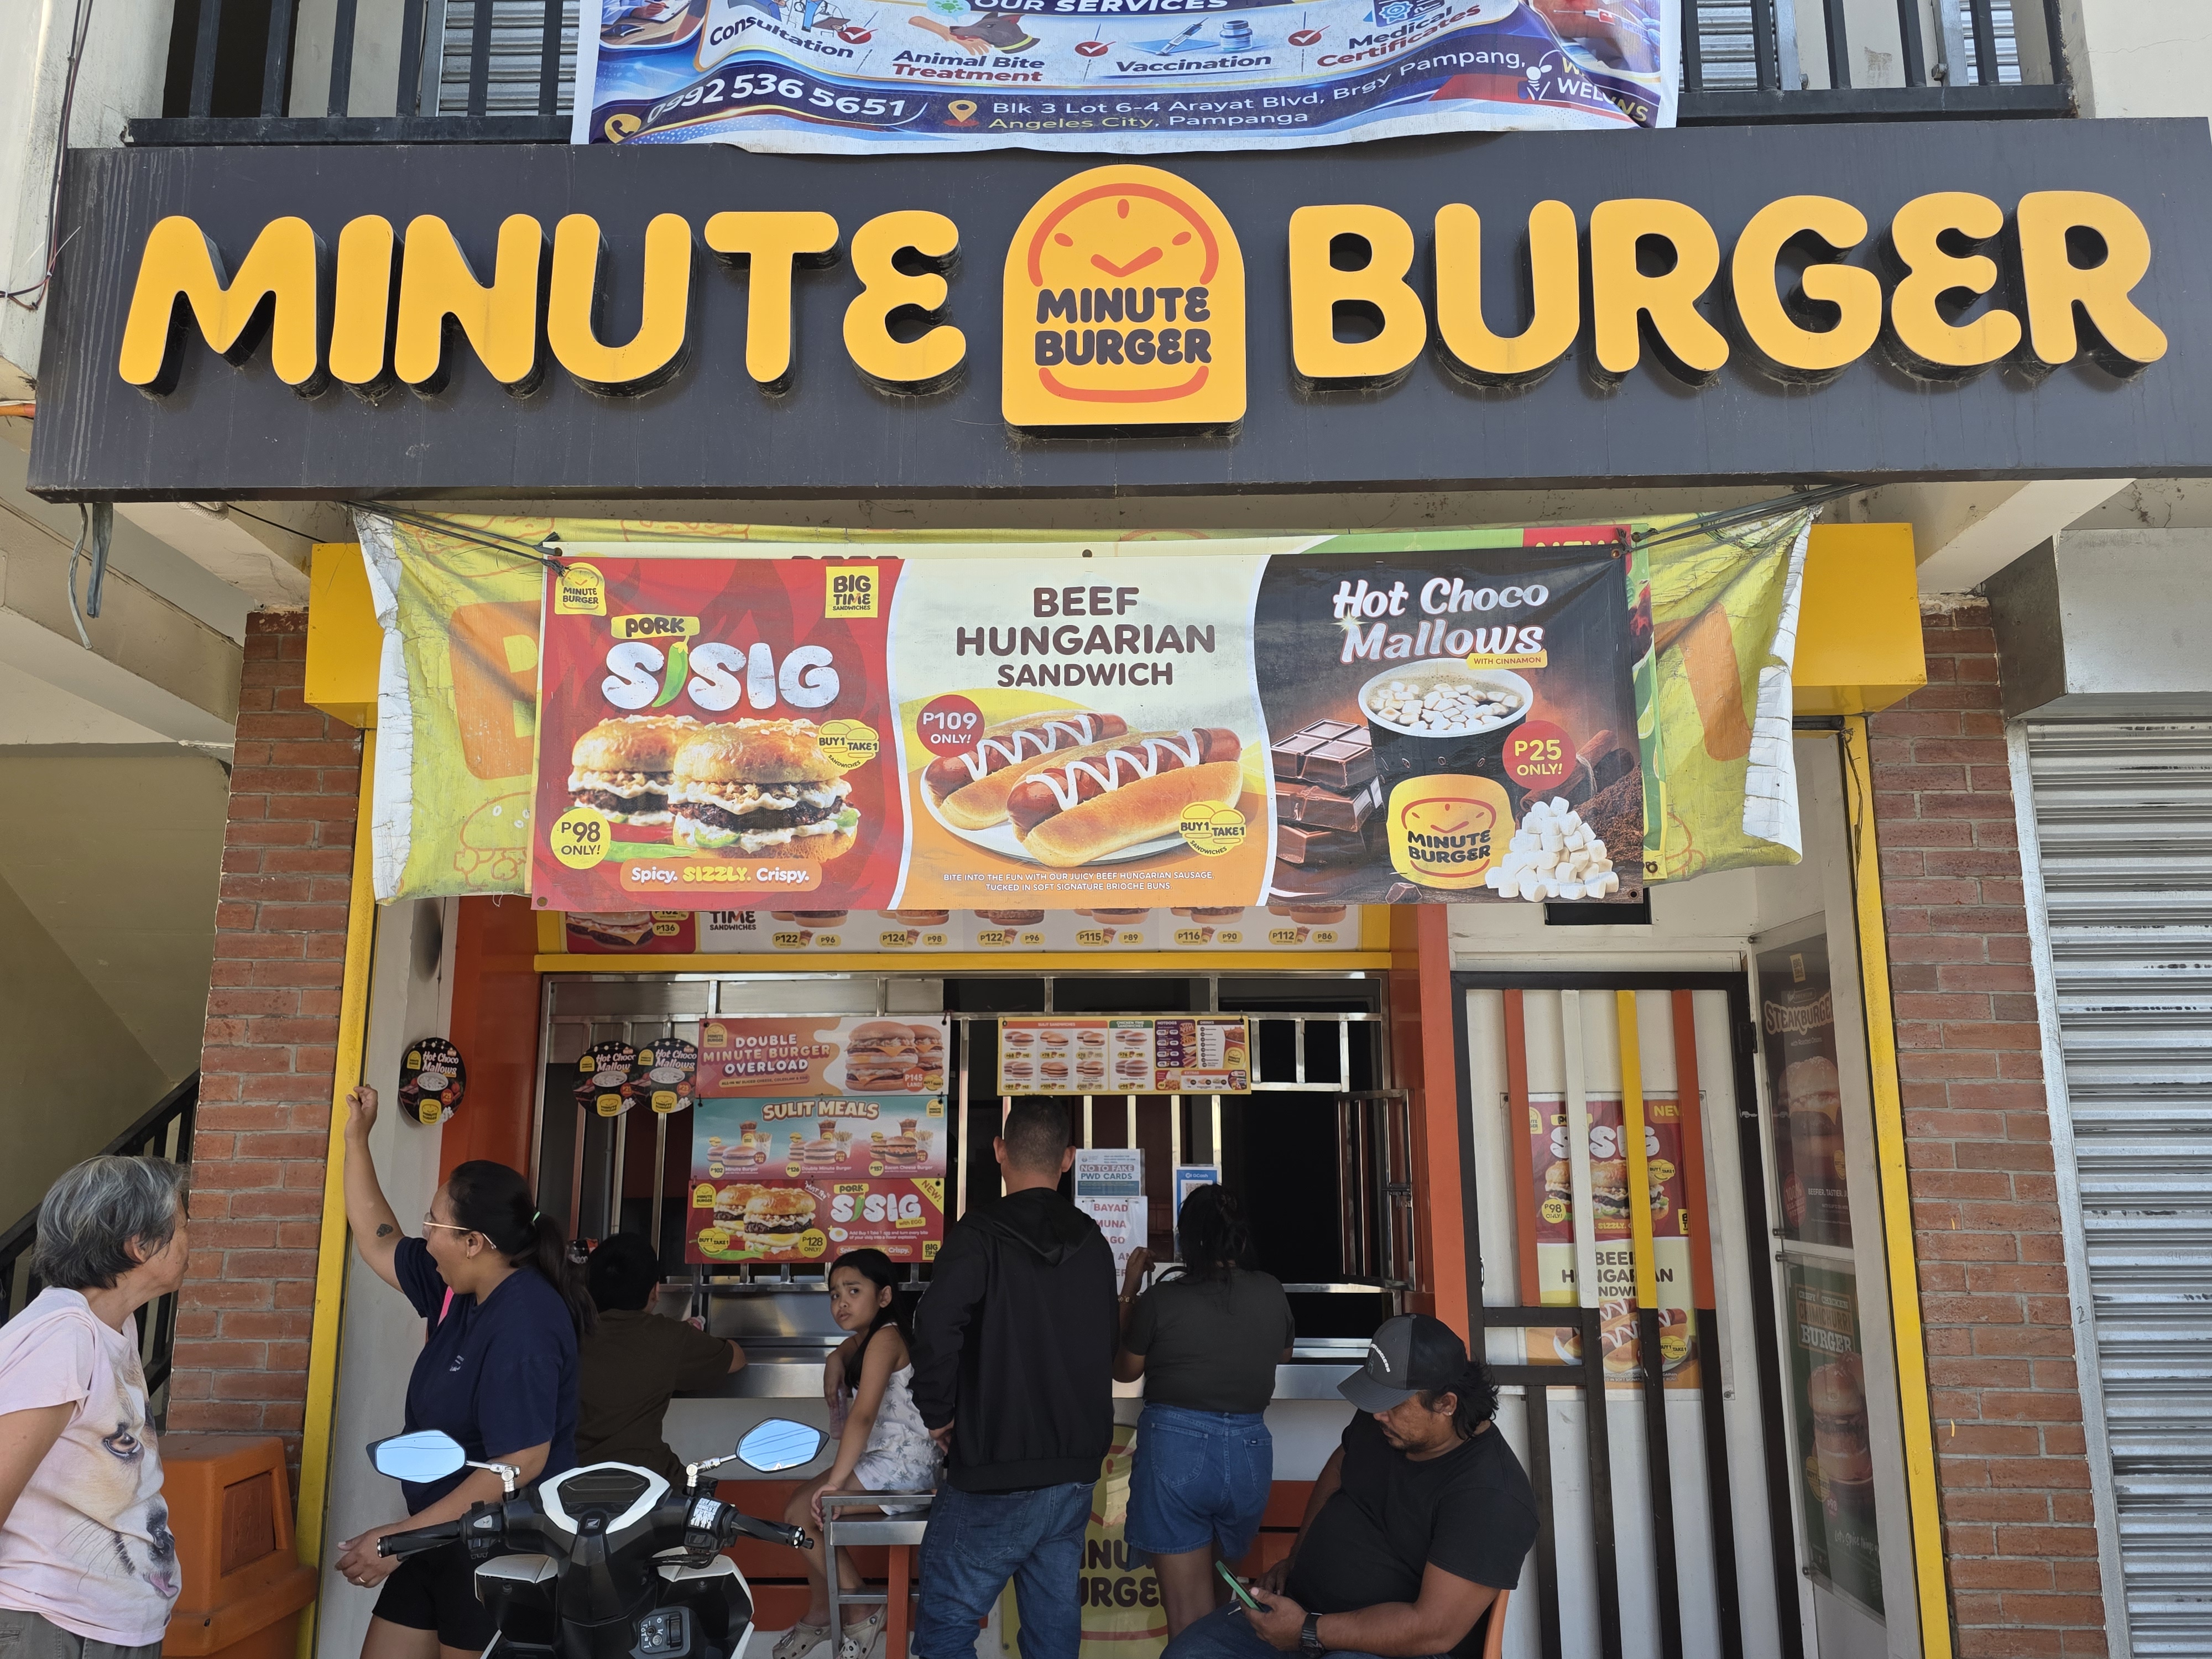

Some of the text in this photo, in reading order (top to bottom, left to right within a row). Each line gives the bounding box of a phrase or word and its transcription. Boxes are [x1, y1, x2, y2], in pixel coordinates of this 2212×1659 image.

[709, 16, 854, 58] Consultation
[1318, 4, 1482, 68] Certificates
[1348, 7, 1452, 50] Medical
[893, 50, 1045, 70] Animal Bite
[1117, 54, 1272, 73] Vaccination
[892, 63, 1044, 84] Treatment
[993, 49, 1526, 114] Blk 3 Lot 6-4 Arayat Blvd, Brgy Pampang,
[646, 74, 906, 125] 0992 536 5651
[988, 112, 1308, 131] Angeles City, Pampanga
[119, 190, 2168, 387] MINUTE BURGER
[1035, 286, 1212, 324] MINUTE
[1034, 328, 1212, 367] BURGER
[563, 586, 597, 596] MINUTE
[833, 575, 872, 593] BIG
[562, 594, 599, 606] BURGER
[833, 592, 870, 606] TIME
[1033, 586, 1140, 618] BEEF
[1333, 577, 1549, 619] Hot Choco
[625, 617, 685, 637] PORK
[956, 624, 1215, 656] HUNGARIAN
[1340, 618, 1546, 664] Mallows
[1495, 656, 1541, 665] CINNAMON
[997, 662, 1173, 687] SANDWICH
[922, 711, 977, 730] P109
[930, 732, 972, 744] ONLY!
[1515, 739, 1562, 761] P25
[828, 754, 861, 768] SANDWICHES
[1516, 763, 1563, 776] ONLY!
[561, 821, 601, 843] P98
[1407, 830, 1491, 848] MINUTE
[561, 844, 601, 855] ONLY!
[1190, 840, 1227, 855] SANDWICHES
[1408, 844, 1491, 863] BURGER
[631, 866, 810, 884] Spicy. SIZZLY. Crispy.
[1120, 872, 1172, 880] HUNGARIAN
[1173, 871, 1215, 880] SAUSAGE,
[710, 911, 756, 924] TIME
[775, 934, 798, 943] P122
[882, 933, 905, 942] P124
[980, 933, 1003, 942] P122
[1079, 932, 1102, 941] P115
[1178, 931, 1200, 940] P116
[1272, 931, 1295, 940] P112
[1766, 996, 1832, 1032] STEAKBURGE
[735, 1034, 797, 1048] DOUBLE
[422, 1051, 459, 1064] Hot Choco
[596, 1053, 612, 1062] Hot
[655, 1049, 697, 1060] Hot Choco
[703, 1045, 830, 1062] MINUTE BURGER
[422, 1060, 457, 1074] Mallows
[597, 1062, 632, 1072] Mallow
[655, 1058, 696, 1069] Mallows
[724, 1058, 808, 1074] OVERLOAD
[762, 1100, 879, 1120] SULIT MEALS
[839, 1183, 864, 1193] PORK
[921, 1180, 943, 1202] NEW!
[1093, 1204, 1129, 1212] BAYAD
[1545, 1203, 1562, 1213] P98
[802, 1237, 823, 1246] P128
[1821, 1296, 1849, 1310] CHICKEN
[1799, 1303, 1851, 1332] CHIMICHURRI
[1801, 1324, 1852, 1354] BURGER
